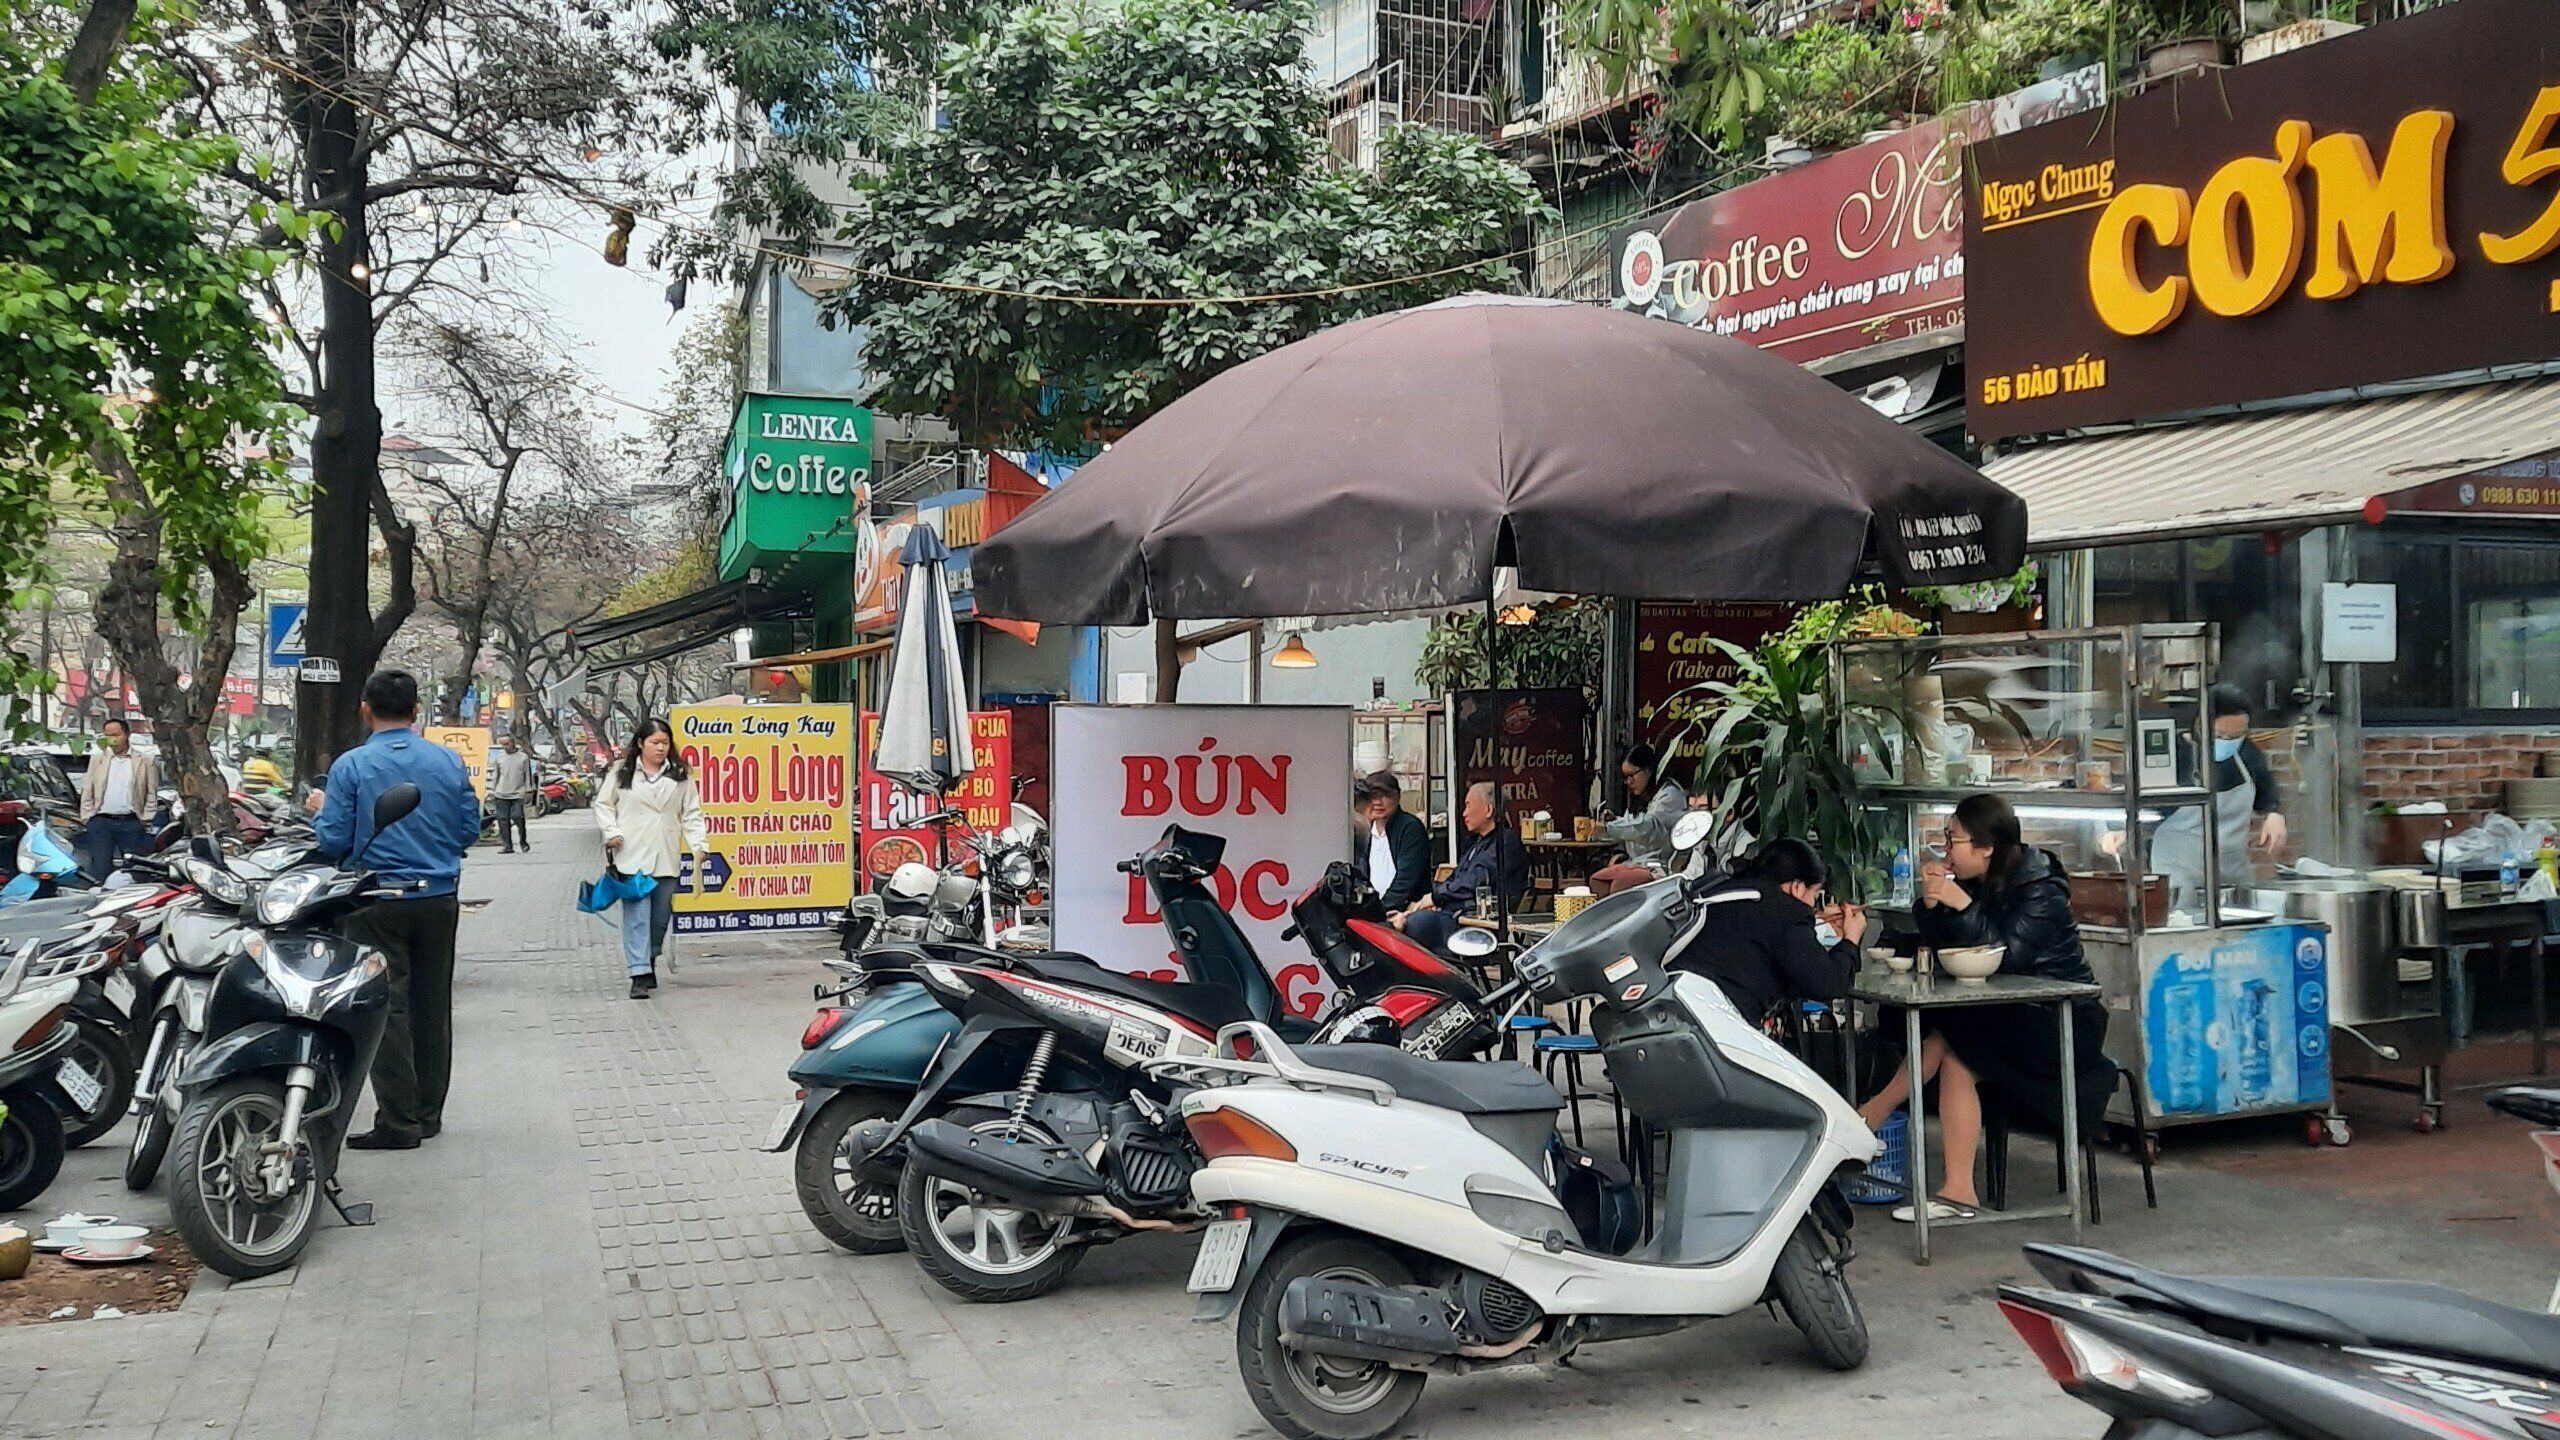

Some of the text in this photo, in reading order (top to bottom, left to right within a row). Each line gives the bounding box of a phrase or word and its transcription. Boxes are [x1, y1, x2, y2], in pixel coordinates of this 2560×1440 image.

[1982, 159, 2115, 220] Ngọc Chung
[2088, 109, 2456, 336] CƠM
[1673, 235, 1808, 309] Coffee
[1716, 310, 1741, 337] hạt
[1742, 297, 1797, 332] nguyên
[1799, 281, 1834, 315] chất
[1835, 279, 1873, 305] rang
[1877, 270, 1910, 296] xay
[1914, 260, 1941, 291] tại
[1983, 352, 2106, 404] 56 ĐÀO TẤN
[761, 412, 858, 442] LENKA
[750, 453, 869, 495] Coffee
[1668, 658, 1714, 683] (Take
[684, 714, 836, 738] Quán Lòng Kay
[977, 718, 1008, 738] CUA
[1527, 749, 1574, 768] coffee
[681, 743, 844, 809] Cháo Lòng
[972, 772, 996, 798] BÒ
[1120, 737, 1292, 816] BÚN
[741, 809, 784, 833] TRẦN
[790, 811, 833, 832] CHÁO
[738, 836, 845, 869] BÚN ĐẬU MẮM TÔM
[792, 875, 812, 895] CAY
[677, 916, 692, 930] 56
[694, 916, 716, 929] Đào
[719, 912, 739, 927] Tấn
[749, 914, 774, 928] Ship
[776, 913, 797, 926] 096
[799, 912, 820, 925] 950
[1319, 1152, 1388, 1174] SPACY
